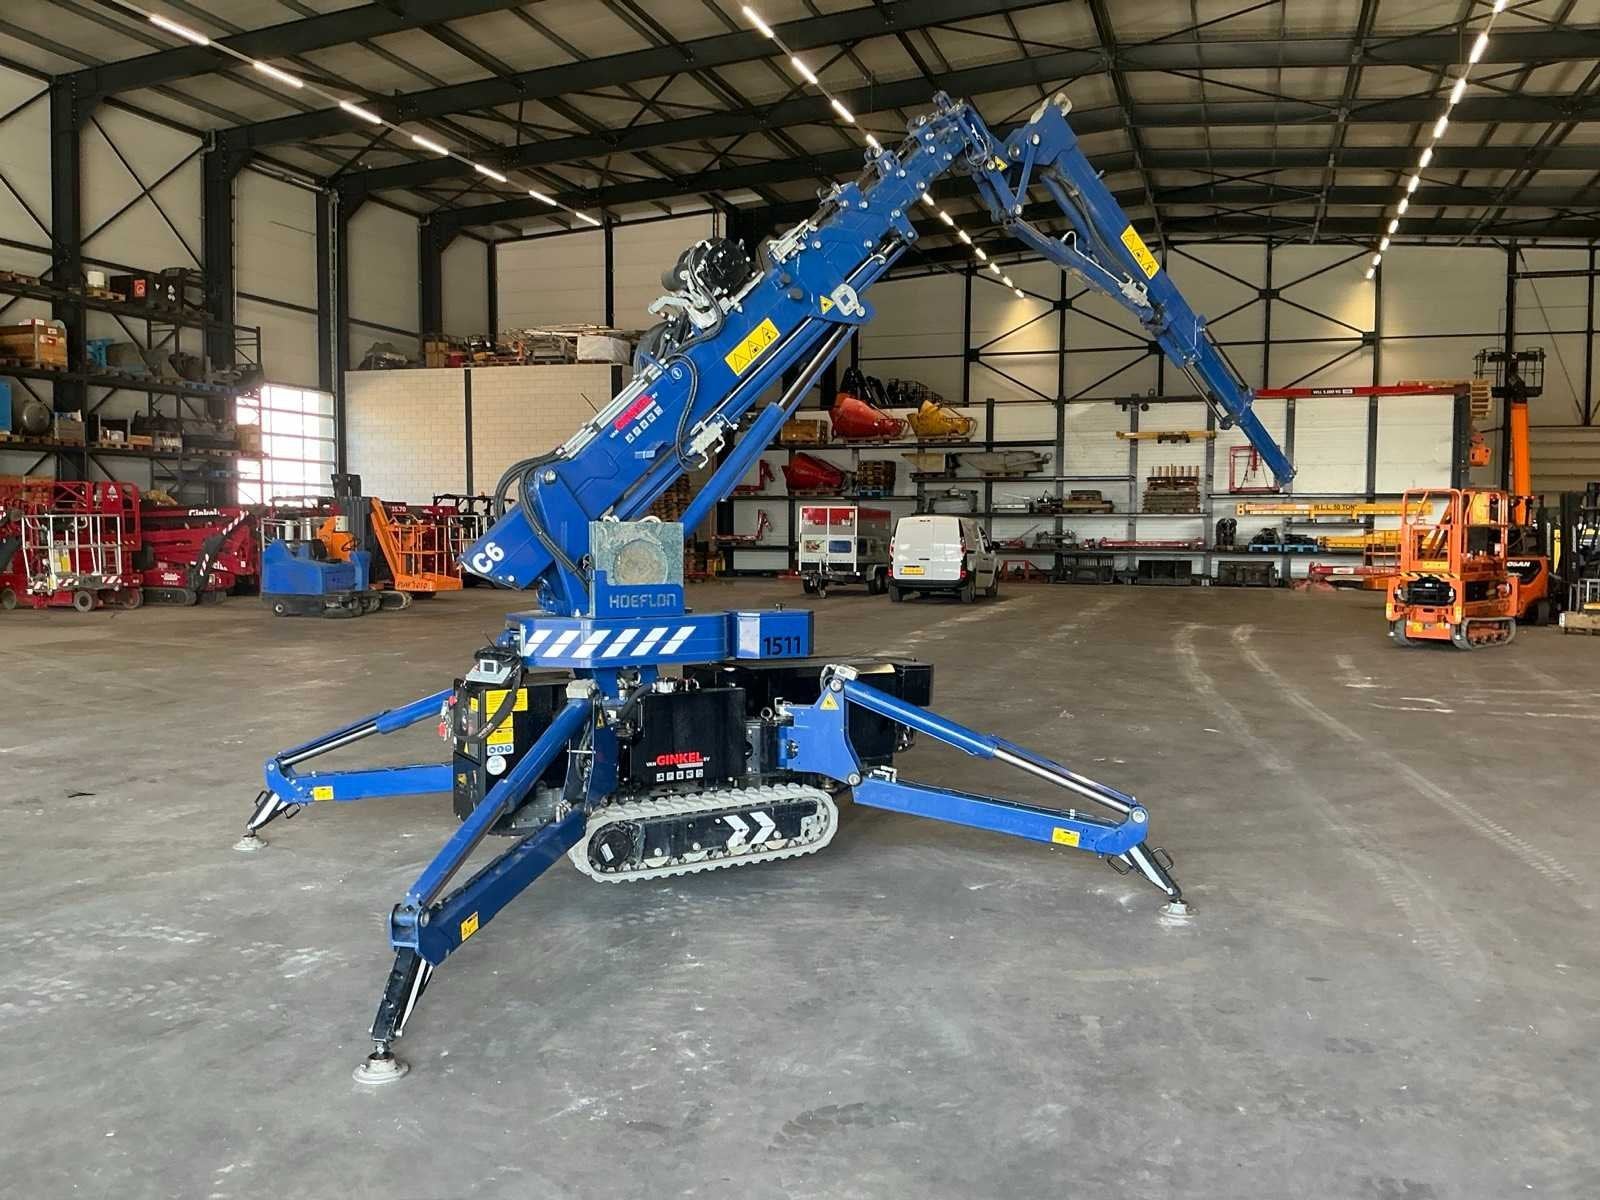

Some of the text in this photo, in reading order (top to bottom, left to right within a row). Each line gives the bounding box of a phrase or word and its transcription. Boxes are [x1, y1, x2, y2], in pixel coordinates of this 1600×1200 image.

[472, 542, 504, 574] C6
[609, 593, 677, 609] HOEFLON
[763, 635, 801, 656] 1511
[656, 751, 704, 766] GINKEL
